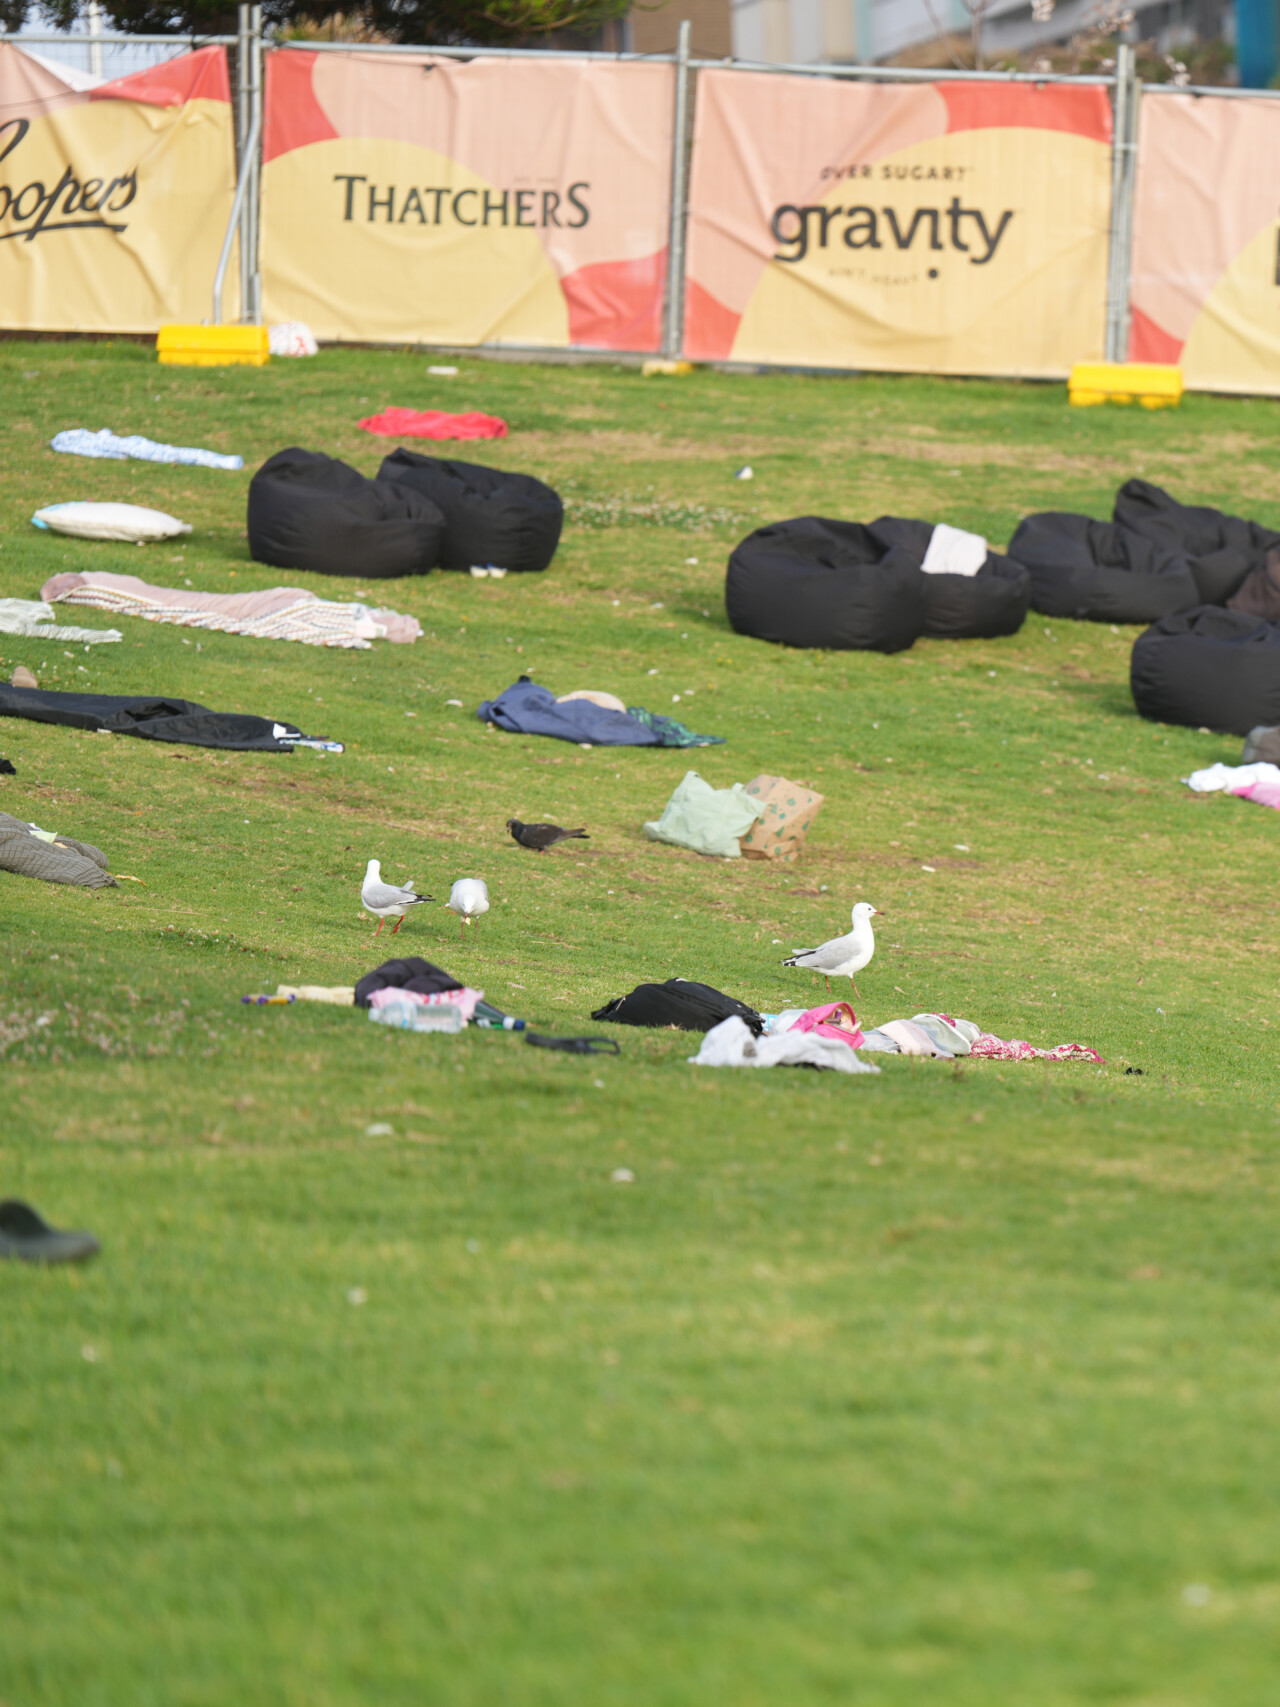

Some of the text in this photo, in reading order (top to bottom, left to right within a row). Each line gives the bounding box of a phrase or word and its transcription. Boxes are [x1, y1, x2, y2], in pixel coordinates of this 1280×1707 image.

[820, 165, 874, 181] OVER
[333, 174, 592, 229] THATCHERS
[771, 197, 1014, 265] gravity
